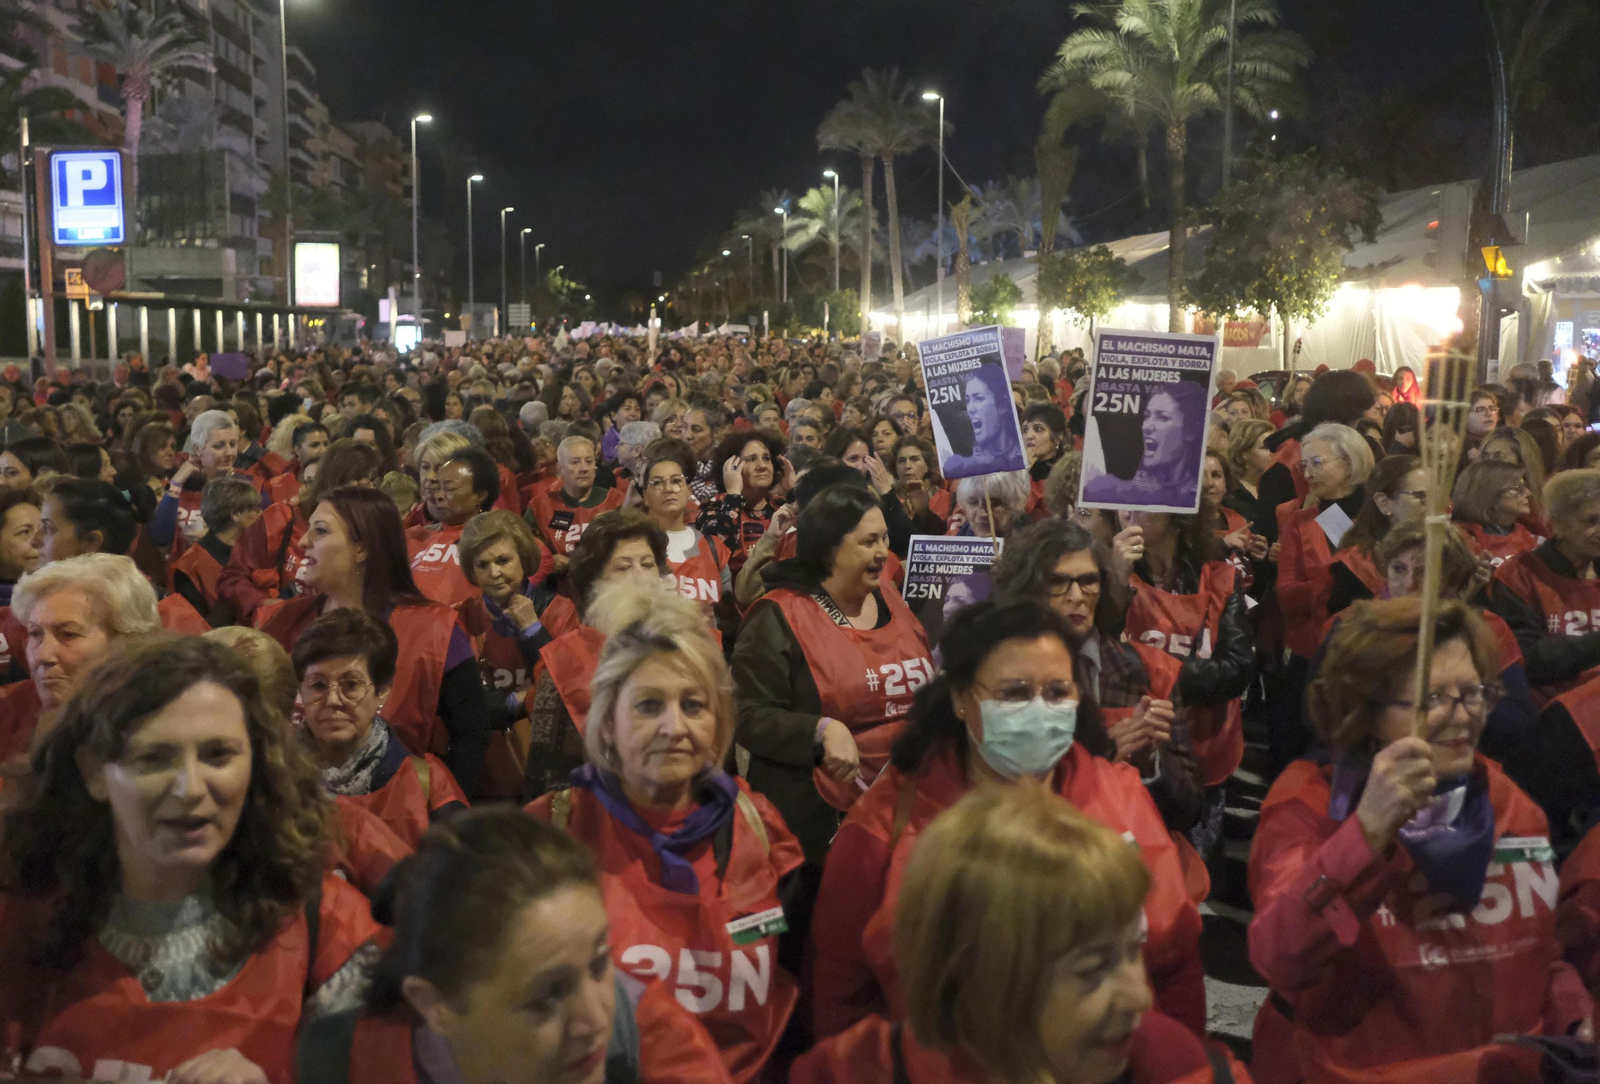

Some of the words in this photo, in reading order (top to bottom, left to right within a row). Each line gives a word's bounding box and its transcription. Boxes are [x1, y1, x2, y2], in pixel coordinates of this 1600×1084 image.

[66, 160, 107, 206] P
[922, 346, 931, 354] EL
[932, 338, 971, 353] MACHISMO
[972, 332, 996, 344] MATA,
[1102, 340, 1114, 350] EL
[1117, 341, 1175, 354] MACHISMO
[1178, 345, 1210, 358] MATA,
[924, 355, 943, 365] VIOLA,
[945, 349, 971, 360] EXPLOTA
[976, 344, 997, 354] BORRA
[1100, 354, 1129, 365] VIOLA,
[1132, 356, 1169, 367] EXPLOTA
[1179, 360, 1208, 369] BORRA
[927, 368, 933, 378] A
[933, 365, 948, 377] LAS
[948, 358, 982, 373] MUJERES
[1098, 367, 1106, 378] A
[1109, 368, 1130, 380] LAS
[1131, 370, 1181, 383] MUJERES
[930, 384, 961, 405] 25N
[1096, 383, 1140, 393] ¡BASTA
[1094, 392, 1140, 414] 25N
[925, 544, 970, 553] MACHISMO
[913, 554, 934, 562] VIOLA,
[910, 564, 917, 573] A
[919, 564, 934, 573] LAS
[935, 565, 974, 575] MUJERES
[907, 583, 942, 599] 25N
